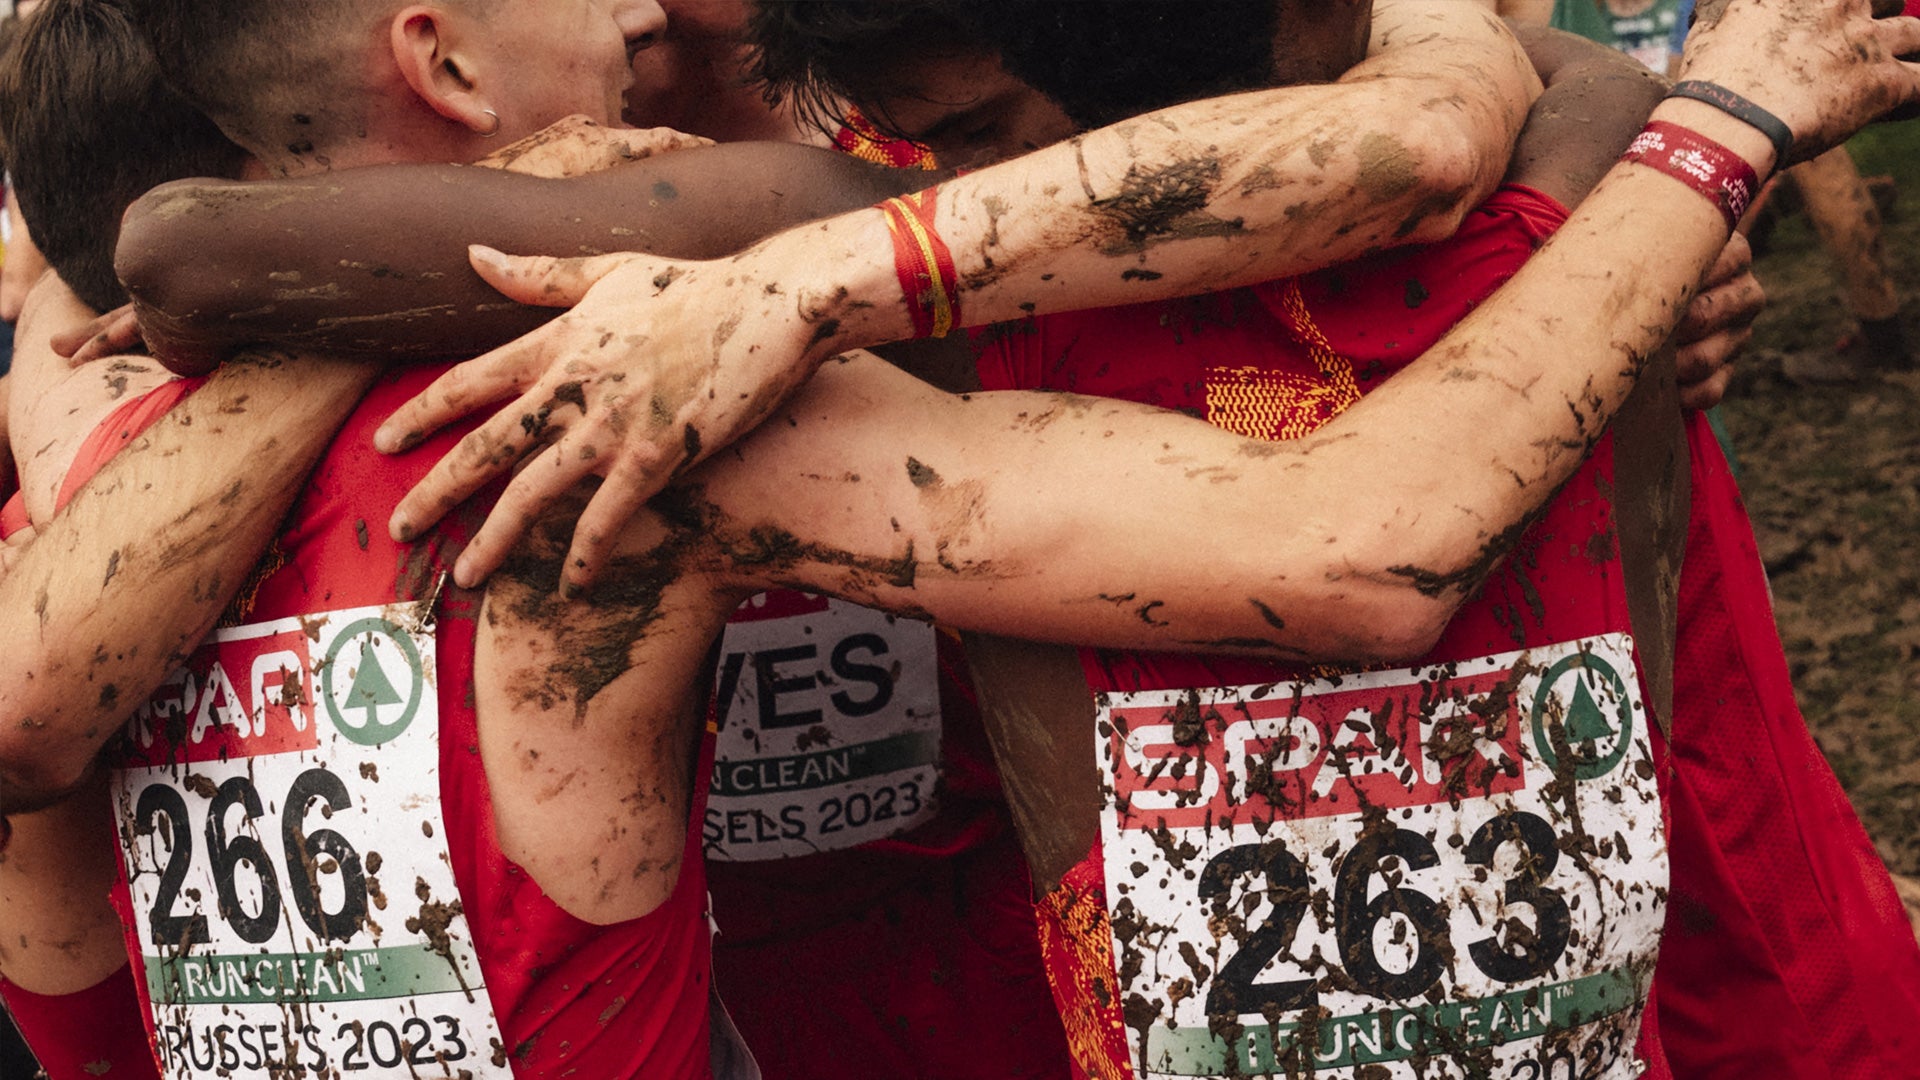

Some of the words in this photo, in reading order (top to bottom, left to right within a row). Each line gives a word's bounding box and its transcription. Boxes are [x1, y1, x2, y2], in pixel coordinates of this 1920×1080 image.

[128, 649, 308, 749] PAR
[1124, 691, 1512, 811] SPAR
[136, 767, 368, 946] 266
[818, 781, 921, 835] 2023
[1198, 810, 1572, 1017] 263
[184, 960, 251, 998] RUN
[155, 1023, 328, 1073] RUSSES
[336, 1014, 468, 1071] 2023
